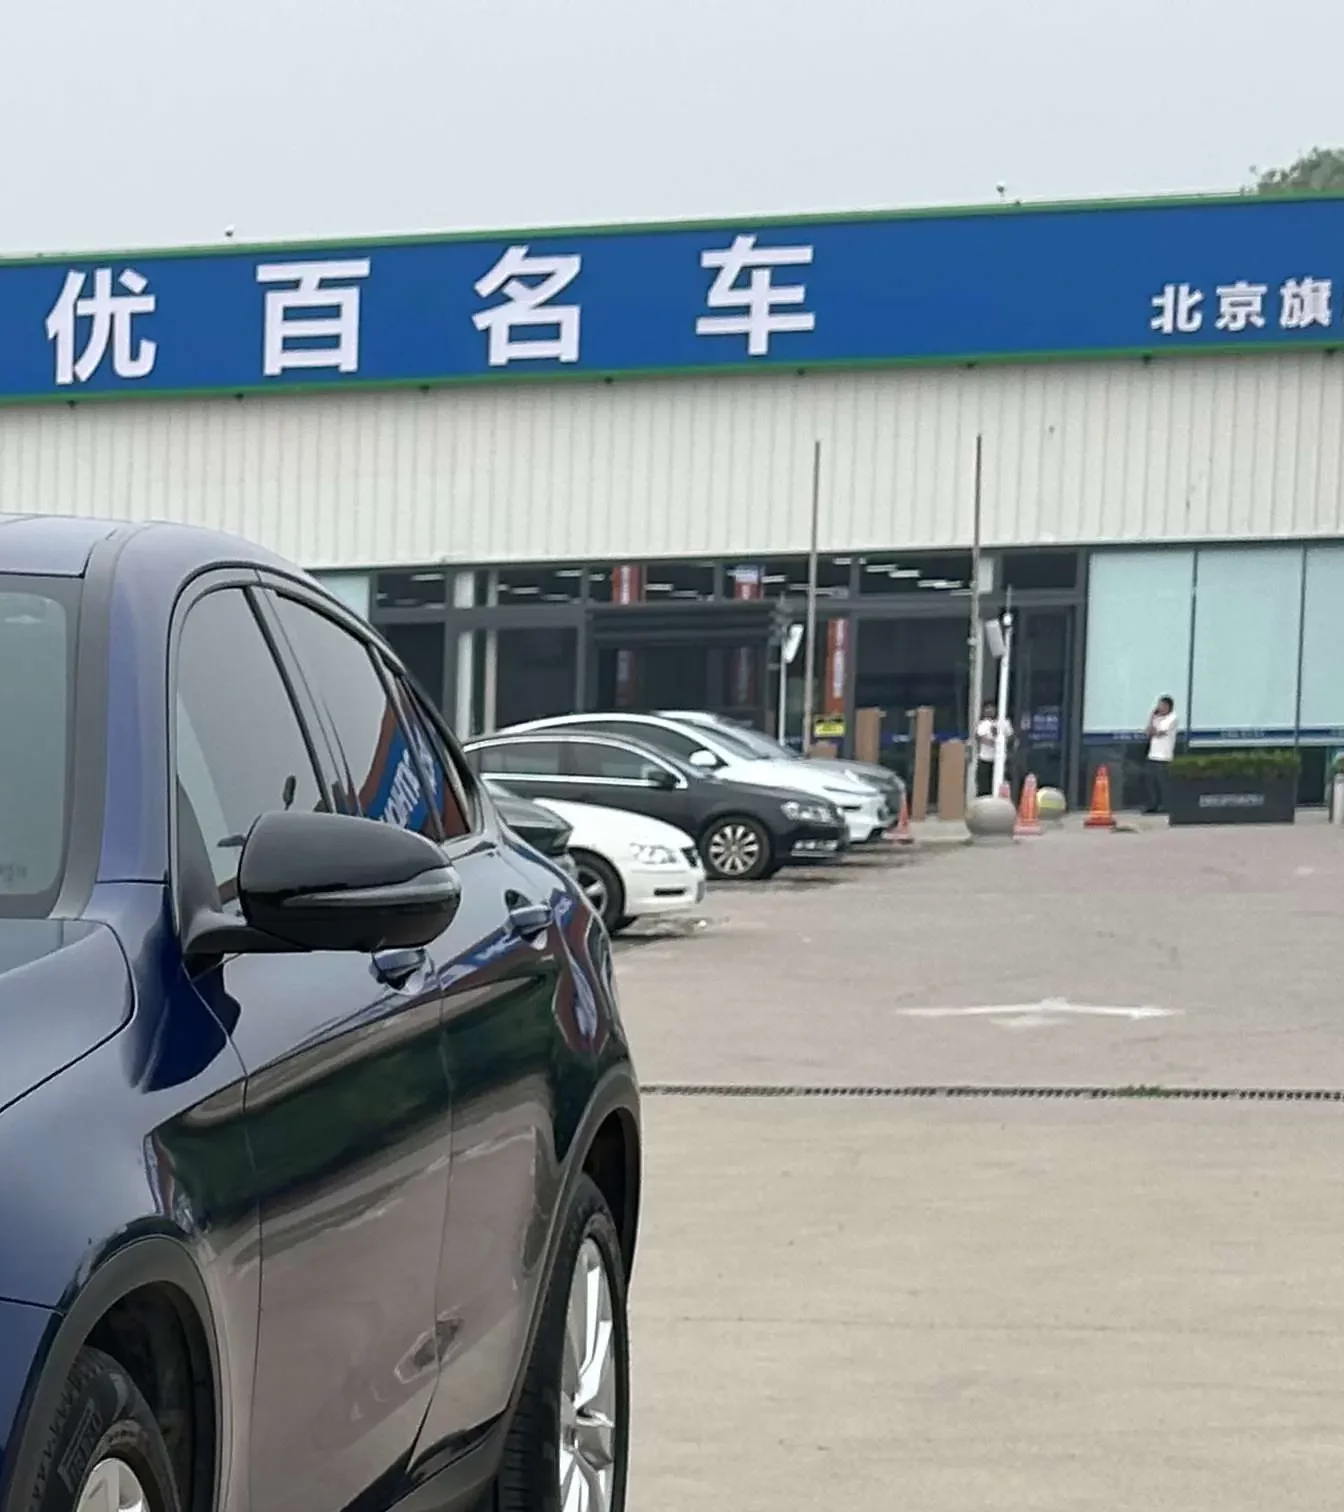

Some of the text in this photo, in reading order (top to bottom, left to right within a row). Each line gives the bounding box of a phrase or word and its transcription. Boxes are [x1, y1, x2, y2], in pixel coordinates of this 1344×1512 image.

[44, 234, 817, 385] 优百名车
[1150, 276, 1333, 335] 北京旗
